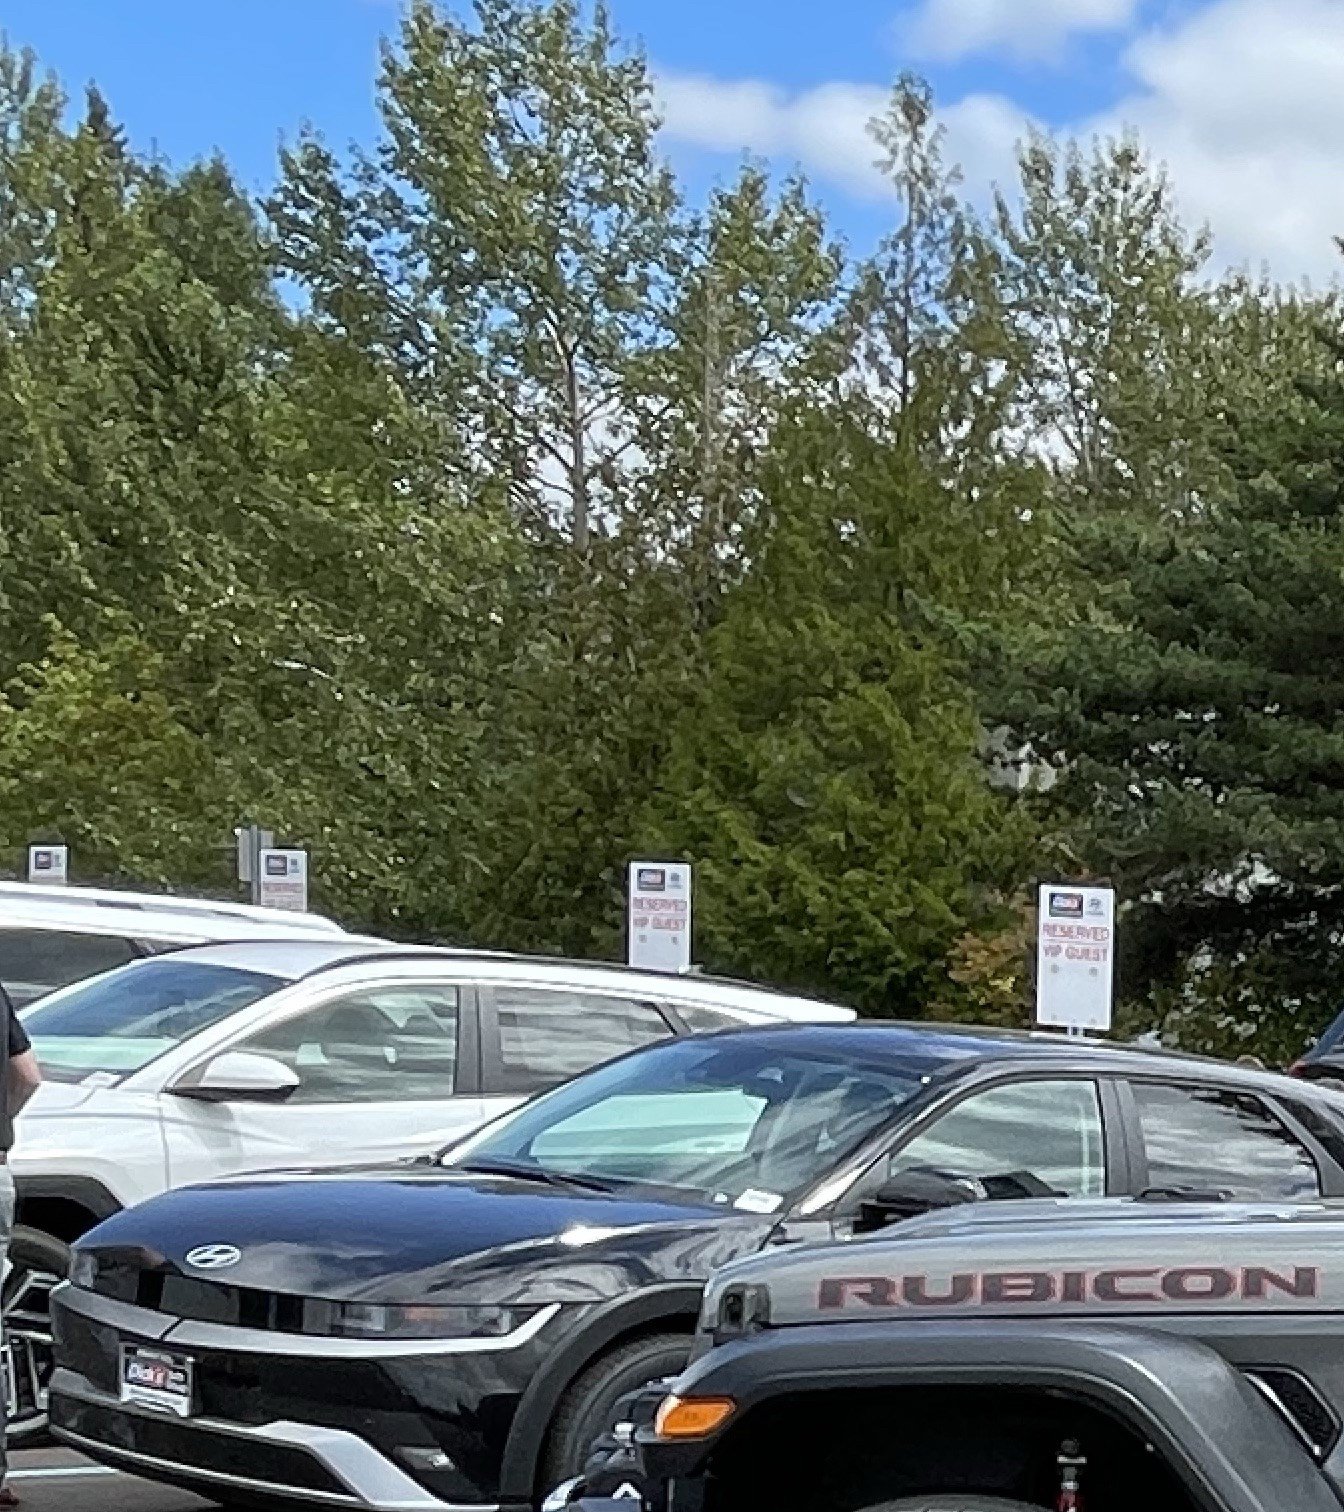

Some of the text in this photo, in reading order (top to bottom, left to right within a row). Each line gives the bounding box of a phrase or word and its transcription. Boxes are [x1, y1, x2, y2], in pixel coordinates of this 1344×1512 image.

[1042, 923, 1110, 942] RESERVED
[1044, 945, 1108, 962] VIP GUEST
[817, 1265, 1320, 1310] RUBICON
